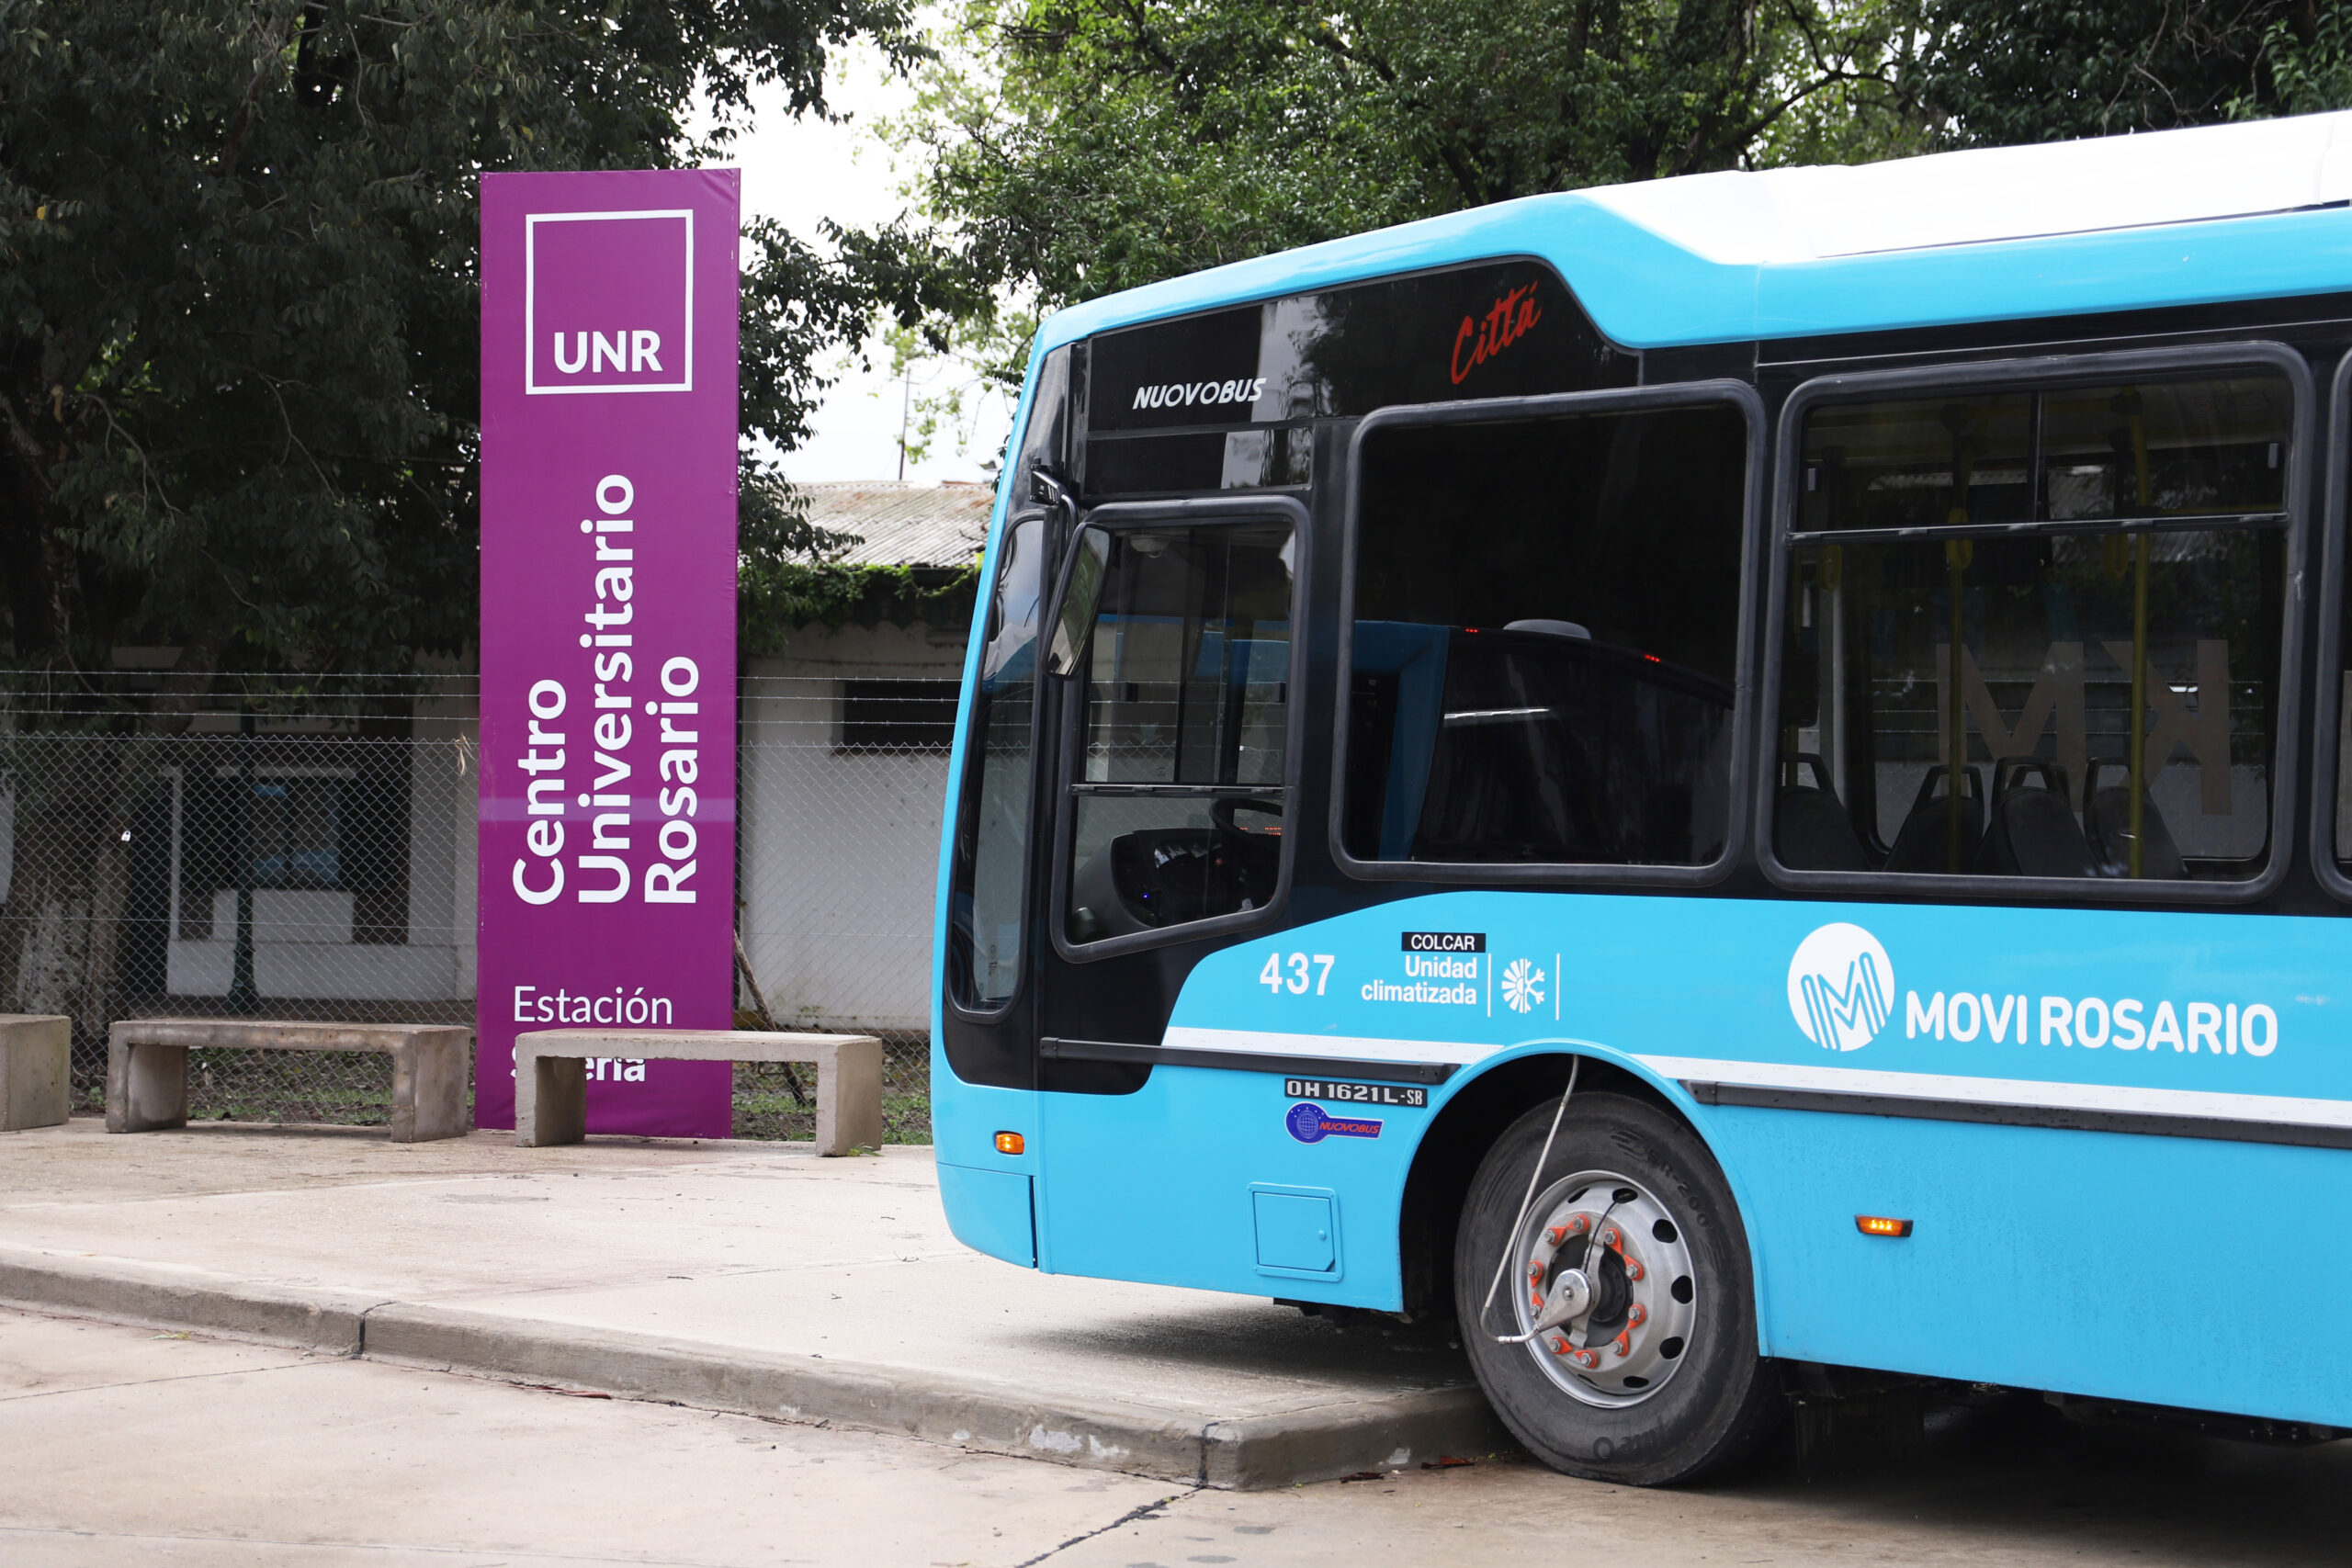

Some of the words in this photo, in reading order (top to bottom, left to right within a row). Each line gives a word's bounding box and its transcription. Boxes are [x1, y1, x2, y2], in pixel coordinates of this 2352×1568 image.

[554, 330, 663, 374] UNR
[1133, 378, 1267, 410] NUOVOBUS
[577, 474, 635, 903] Universitario
[512, 679, 567, 905] Centro
[644, 656, 699, 904] Rosario
[1410, 934, 1476, 951] COLCAR
[1259, 953, 1335, 996] 437
[1405, 954, 1477, 979] Unidad
[514, 986, 673, 1024] Estación
[1361, 979, 1477, 1005] climatizada
[1905, 990, 2028, 1045] MOVI
[2040, 996, 2278, 1057] ROSARIO
[1319, 1122, 1380, 1134] NUOVOBUS
